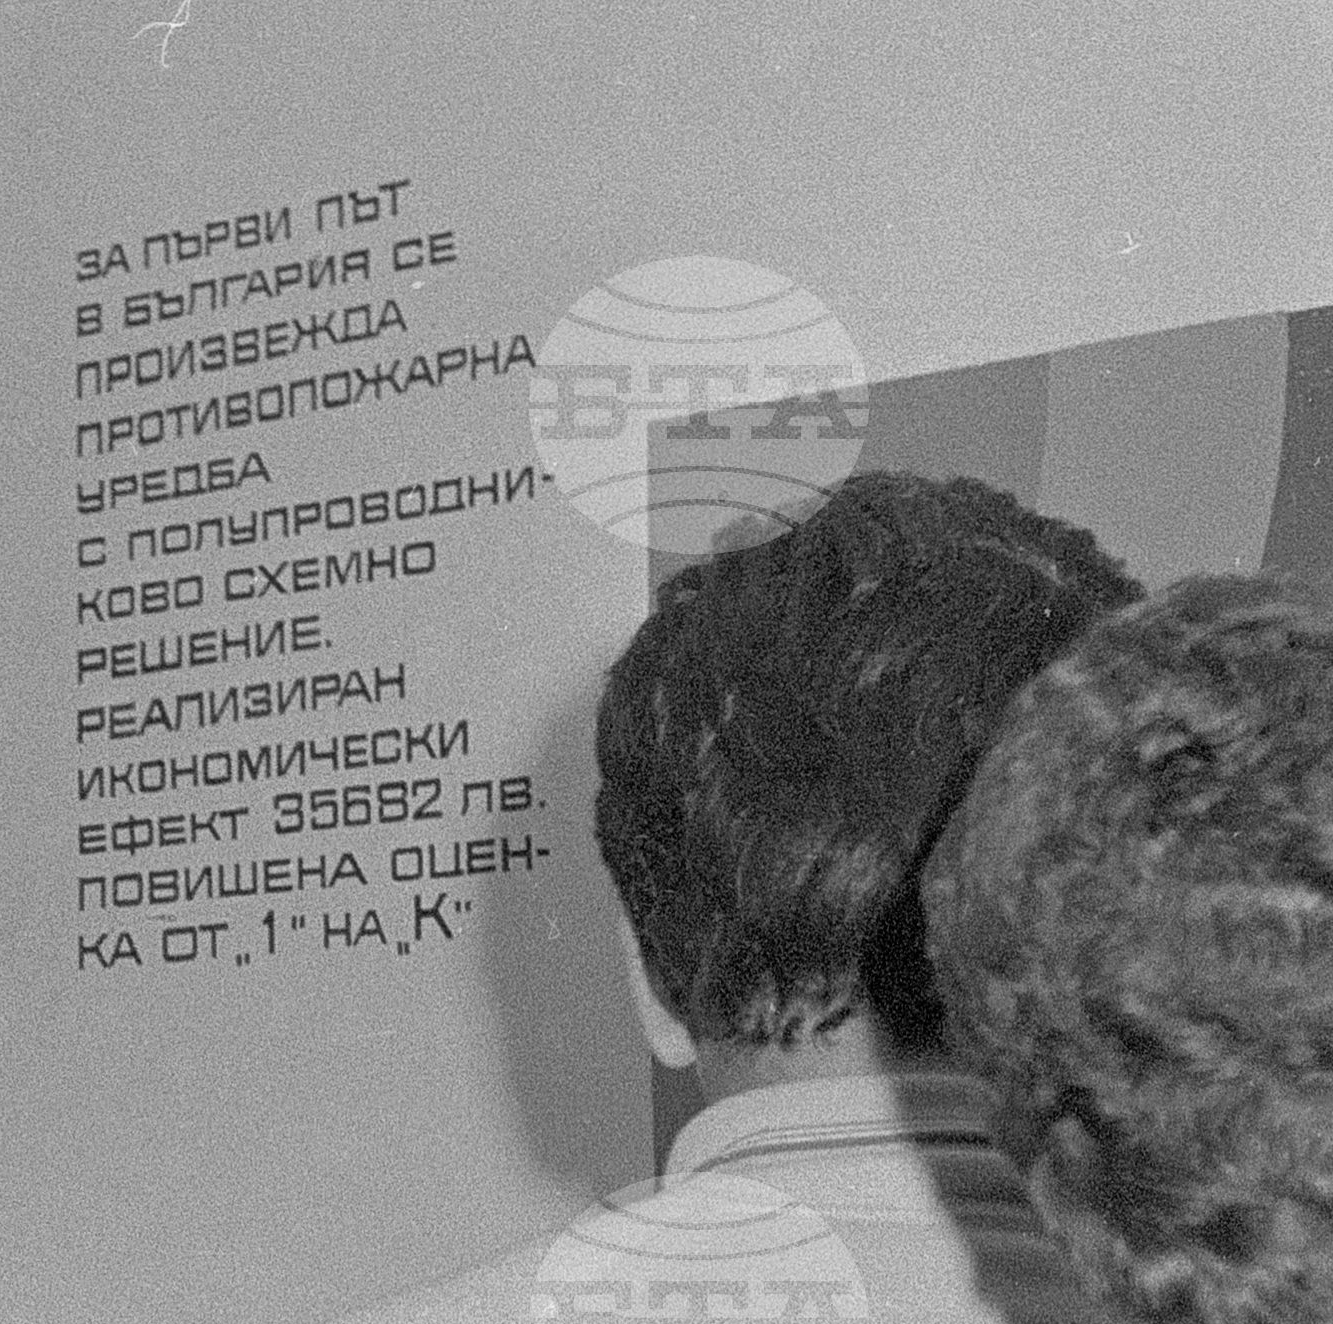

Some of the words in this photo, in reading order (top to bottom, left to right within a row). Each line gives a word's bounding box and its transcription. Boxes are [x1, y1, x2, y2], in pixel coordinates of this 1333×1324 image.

[77, 243, 130, 282] ЗА
[143, 208, 291, 269] ПЪРВИ
[316, 179, 411, 231] ПЪТ
[76, 303, 103, 337] В
[124, 249, 371, 327] БЪЛГАРИЯ
[393, 231, 457, 272] СЕ
[76, 300, 408, 399] ПРОИЗВЕЖДА
[77, 335, 537, 457] ПРОТИВОПОЖАРНА
[78, 452, 272, 514] УРЕДБА
[78, 537, 106, 568] С
[129, 466, 554, 559] ПОЛУПРОВОДНИ-
[78, 575, 204, 623] КОВО
[225, 541, 436, 600] СХЕМНО
[77, 615, 332, 684] РЕШЕНИЕ.
[77, 663, 406, 743] РЕАЛИЗИРАН
[78, 720, 471, 800] ИКОНОМИЧЕСКИ
[79, 807, 249, 855] ЕФЕКТ
[274, 778, 443, 835] 35682
[462, 776, 546, 816] ЛВ.
[78, 852, 368, 911] ПОВИШЕНА
[391, 835, 550, 882] ОЦЕН-
[78, 933, 141, 970] КА
[162, 923, 228, 962] ОТ
[323, 910, 386, 949] НА
